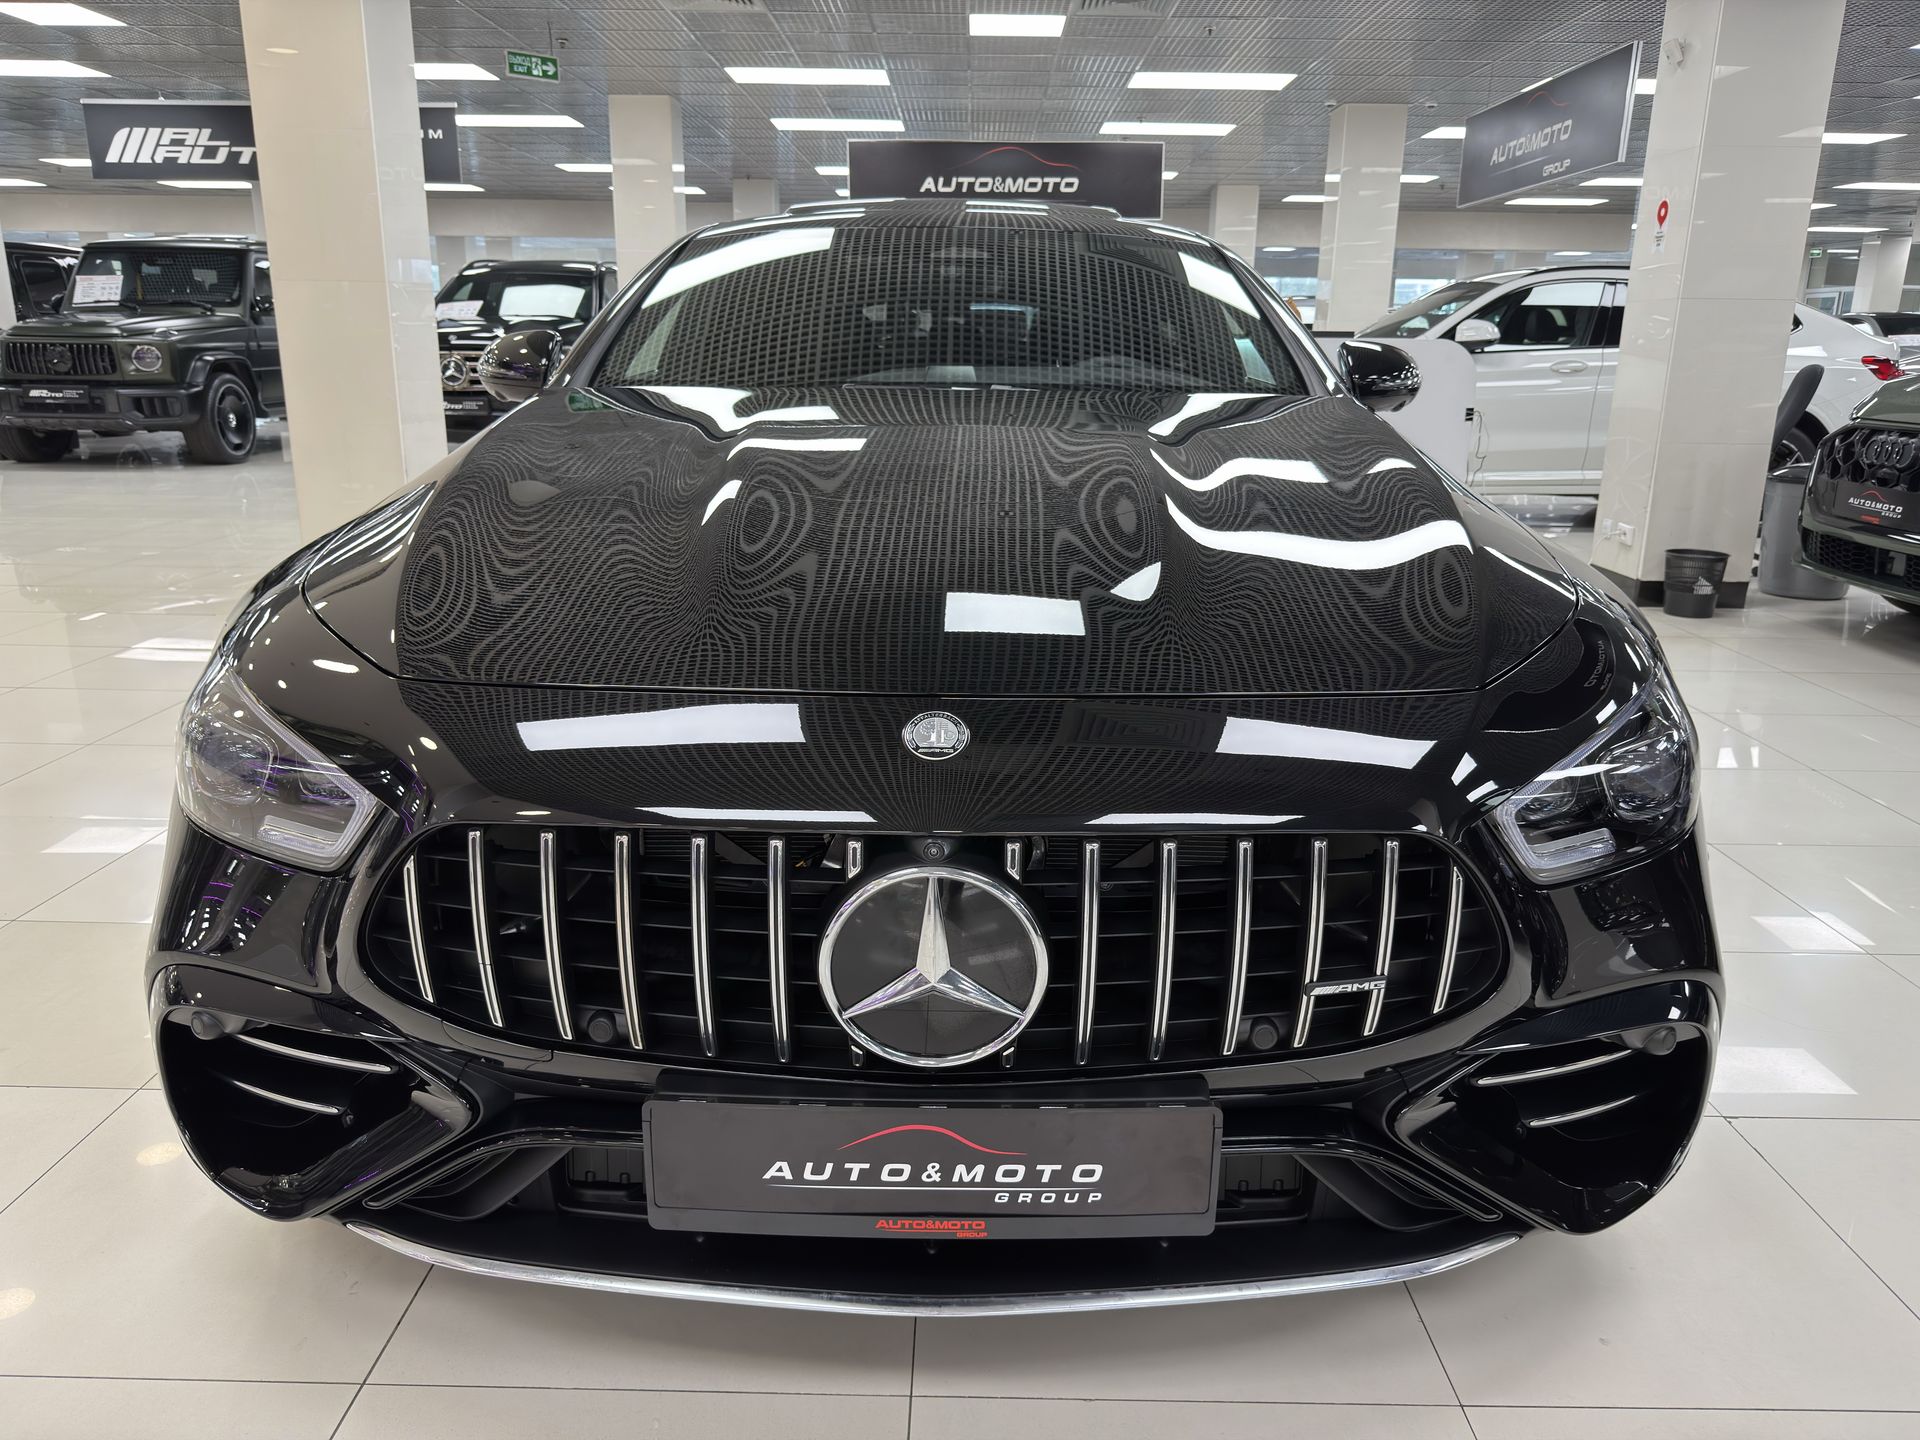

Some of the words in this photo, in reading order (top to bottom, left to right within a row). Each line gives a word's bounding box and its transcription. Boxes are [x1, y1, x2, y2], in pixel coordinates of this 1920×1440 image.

[1490, 119, 1572, 166] AUTO&MOTO
[1542, 158, 1571, 177] GROUP
[919, 176, 1079, 193] AUTO&MOTO
[1848, 497, 1903, 513] AUTO&MOTO
[1337, 980, 1386, 993] AMG
[762, 1161, 1103, 1183] AUTO&MOTO
[994, 1193, 1102, 1204] GROUP
[875, 1219, 986, 1230] AUTO&MOTO
